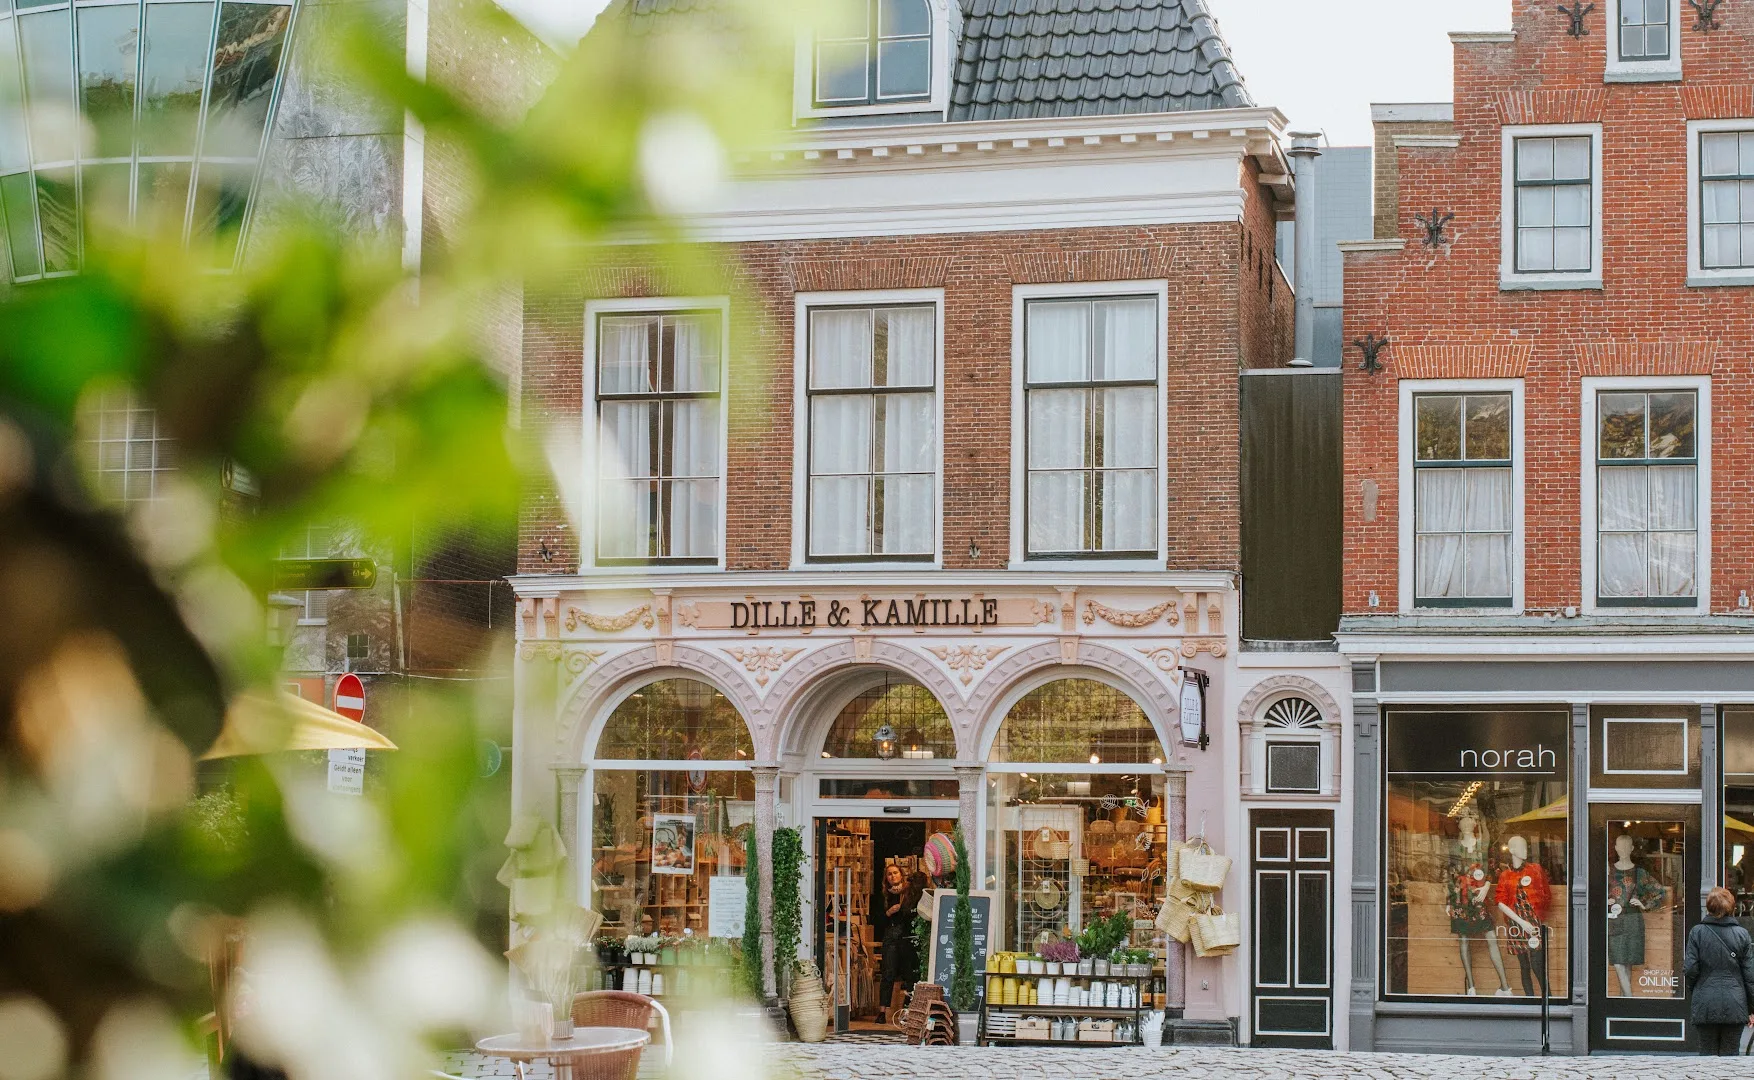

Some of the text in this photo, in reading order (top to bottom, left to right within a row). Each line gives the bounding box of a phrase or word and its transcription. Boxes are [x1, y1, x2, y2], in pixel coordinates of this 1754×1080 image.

[730, 598, 998, 629] DILLE & KAMILLE
[1460, 743, 1556, 768] norah
[1638, 976, 1679, 986] ONLINE
